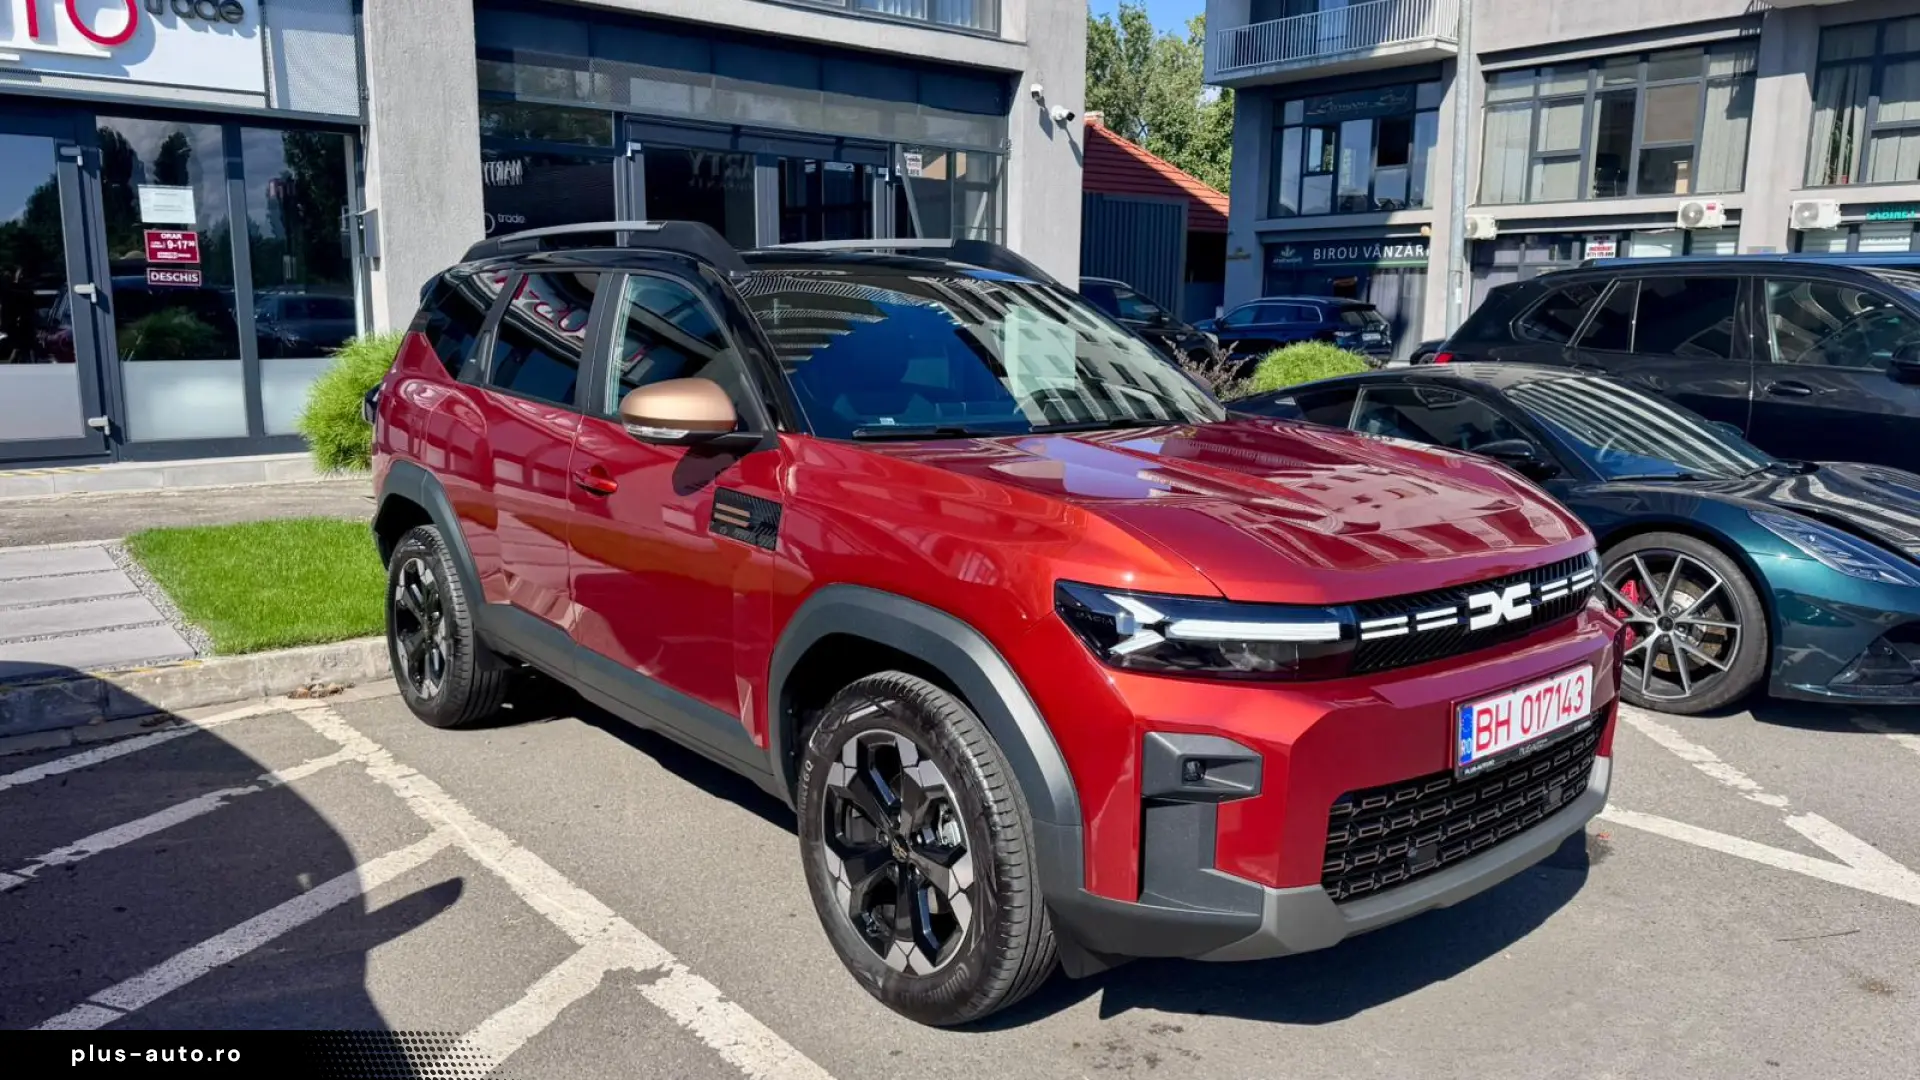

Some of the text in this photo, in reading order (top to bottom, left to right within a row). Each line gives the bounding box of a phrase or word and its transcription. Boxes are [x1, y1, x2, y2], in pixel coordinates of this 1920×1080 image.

[1313, 243, 1430, 260] BIROU VÂNZĂR
[150, 271, 199, 283] DESCHIS
[1476, 675, 1585, 752] BH 017143
